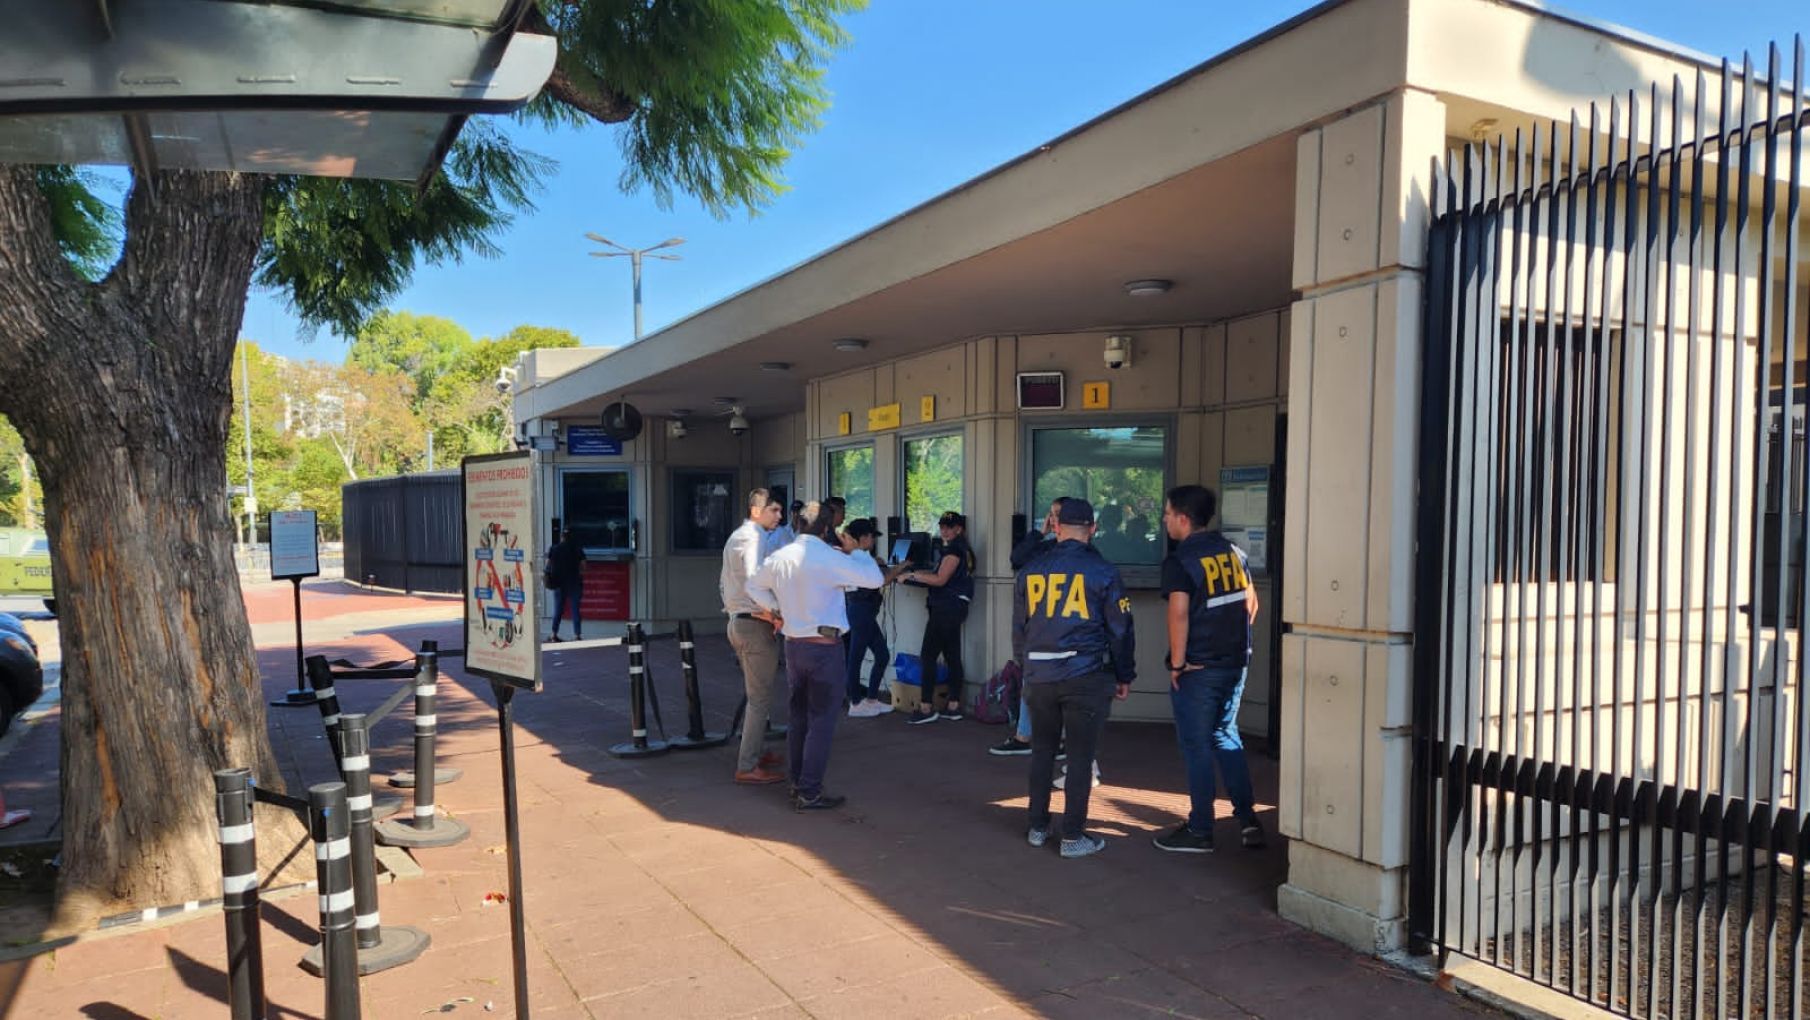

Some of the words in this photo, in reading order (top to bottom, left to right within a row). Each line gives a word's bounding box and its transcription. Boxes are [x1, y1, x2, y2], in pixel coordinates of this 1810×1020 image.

[1091, 387, 1099, 404] 1
[1026, 573, 1090, 620] PFA
[1199, 552, 1249, 597] PFA
